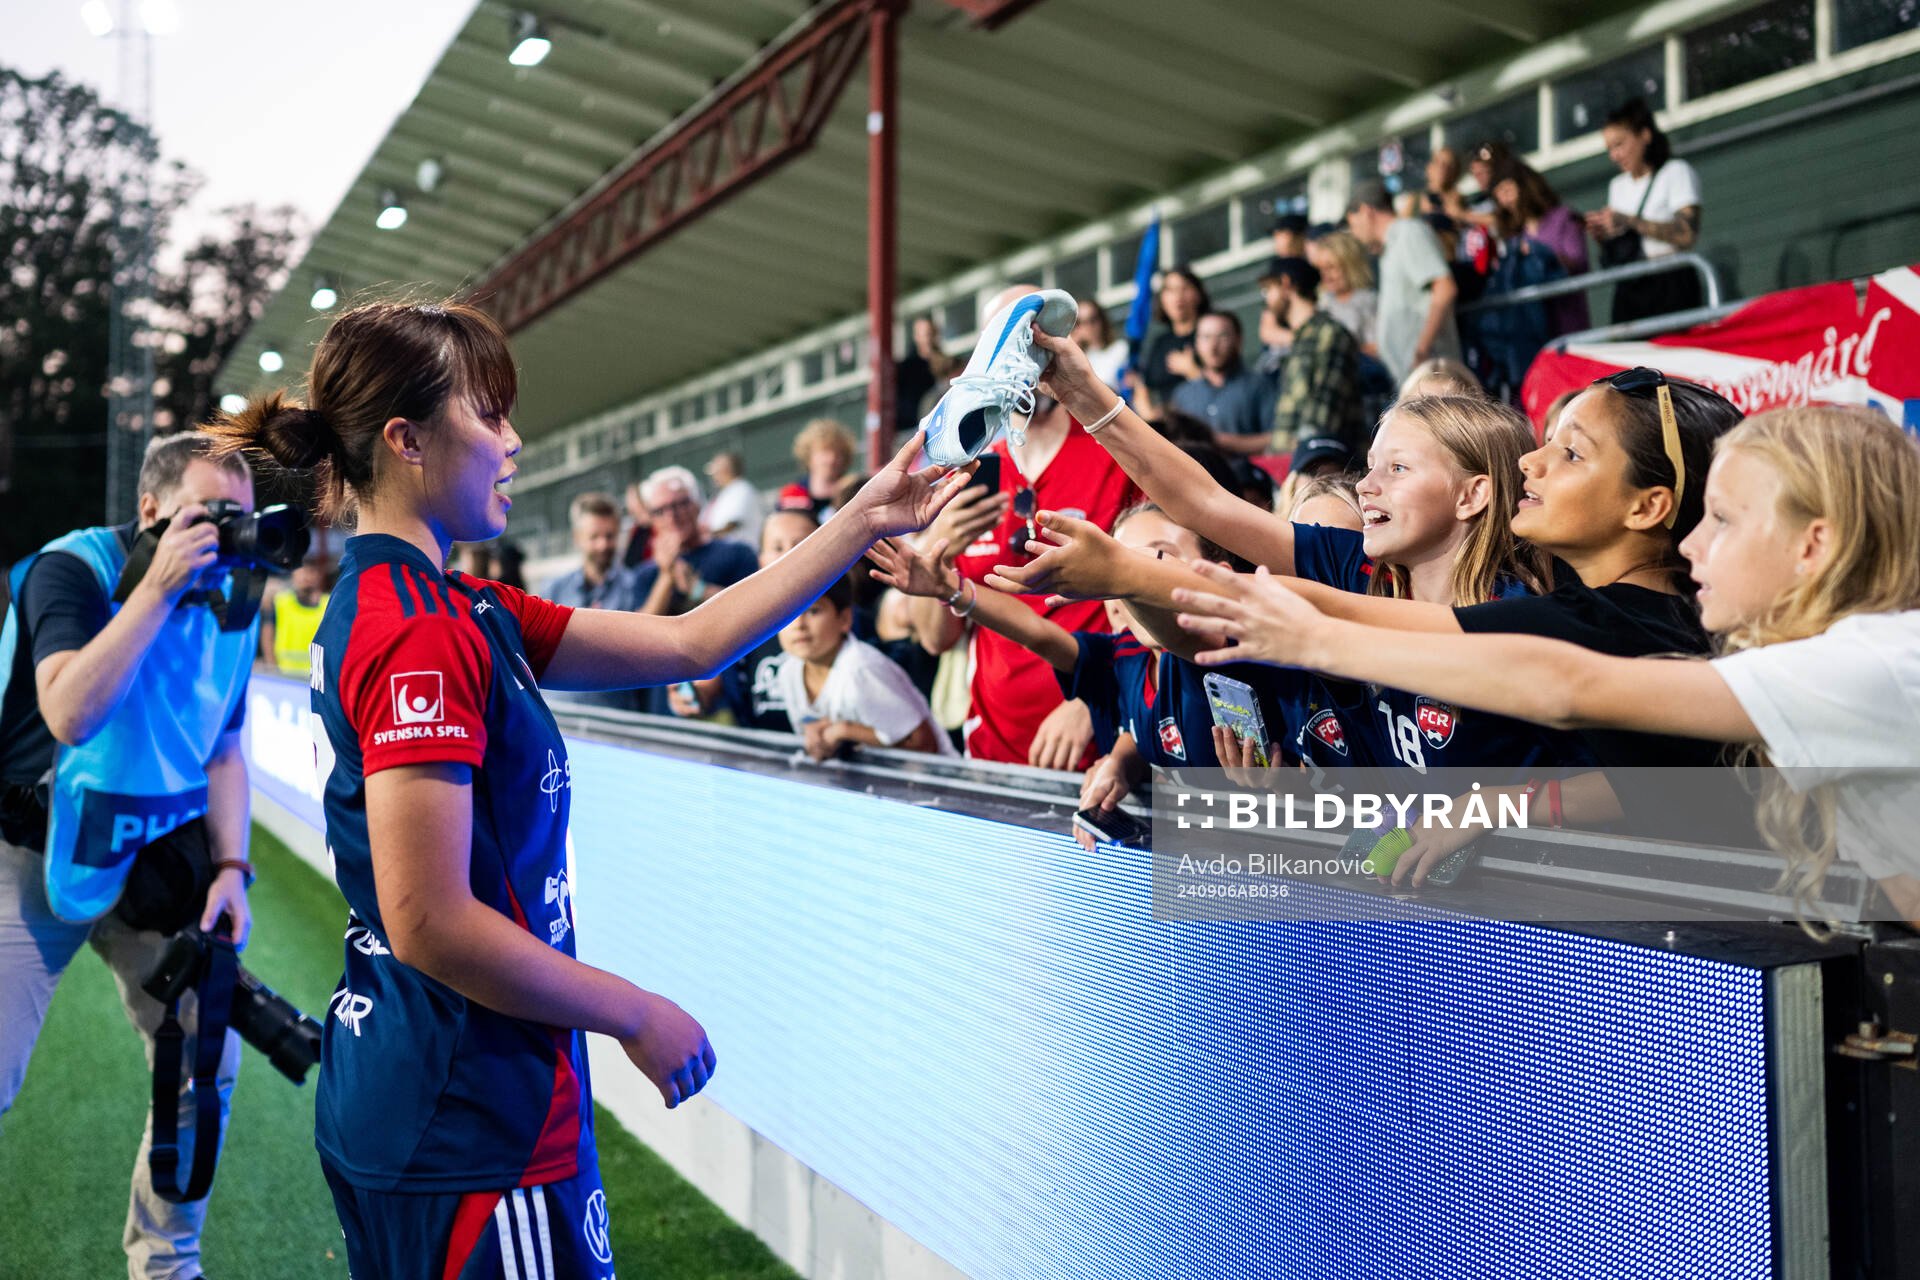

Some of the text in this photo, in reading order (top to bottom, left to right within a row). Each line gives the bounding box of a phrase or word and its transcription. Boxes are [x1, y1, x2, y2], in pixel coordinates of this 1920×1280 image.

[1698, 307, 1892, 413] osengård
[1420, 707, 1449, 727] FCR
[374, 725, 469, 745] SVENSKA SPEL
[1318, 719, 1341, 738] FCR
[1378, 700, 1427, 775] 18
